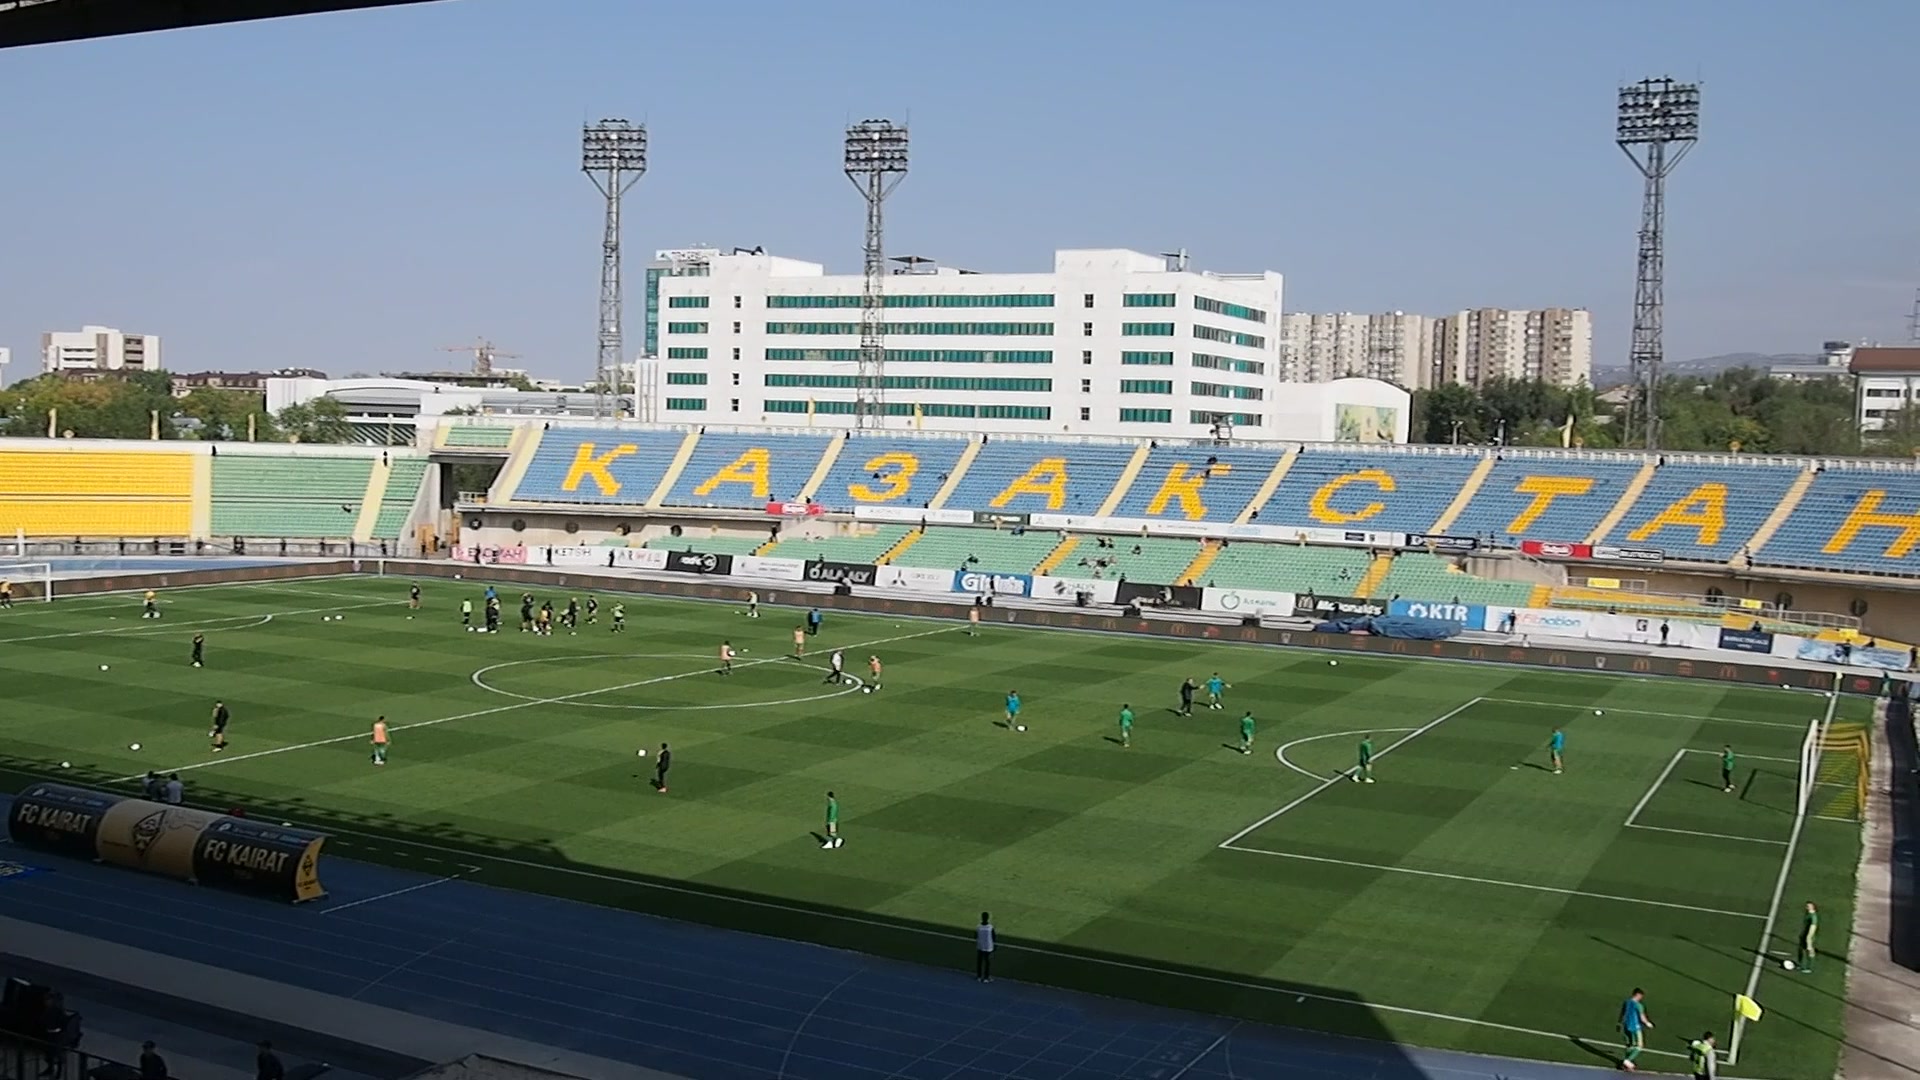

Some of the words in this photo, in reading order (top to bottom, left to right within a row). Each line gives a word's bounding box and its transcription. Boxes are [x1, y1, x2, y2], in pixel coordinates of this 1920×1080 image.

[1429, 603, 1468, 621] KTR
[17, 802, 40, 824] FC
[37, 806, 92, 834] KAIRAT
[203, 839, 227, 862] FC
[227, 843, 290, 872] KAIRAT
